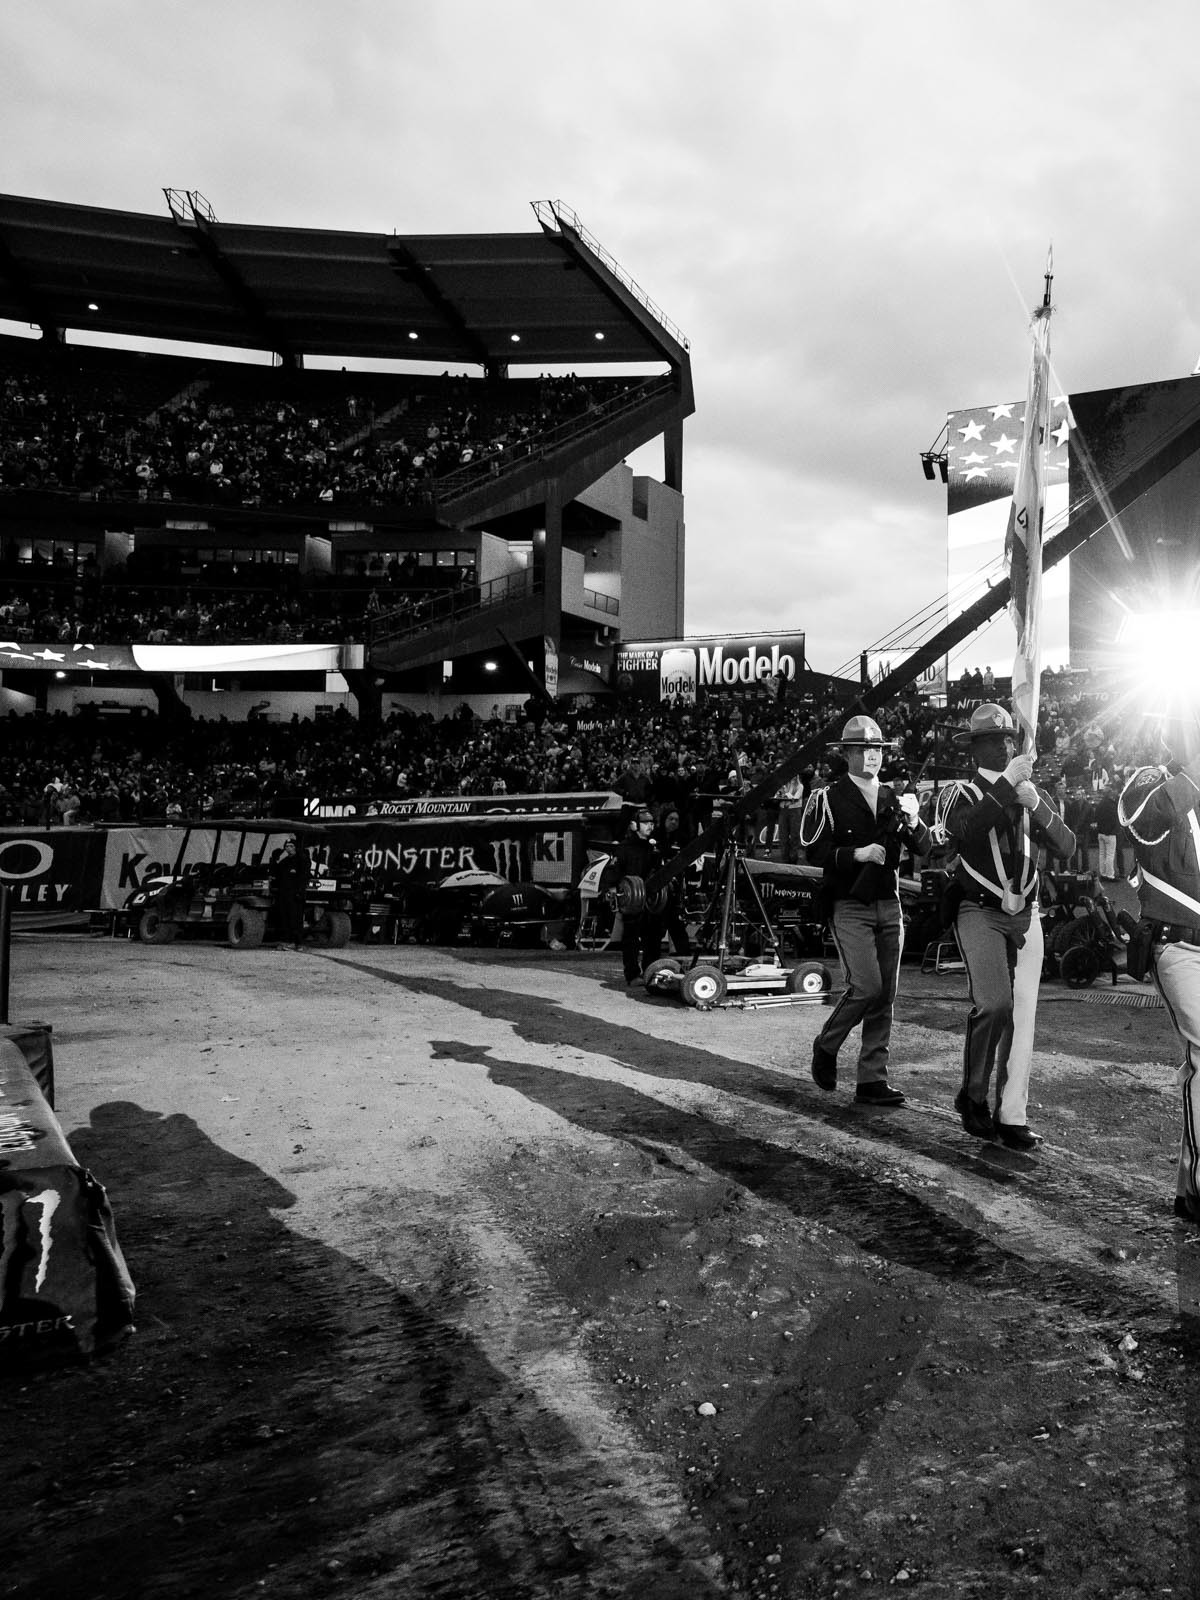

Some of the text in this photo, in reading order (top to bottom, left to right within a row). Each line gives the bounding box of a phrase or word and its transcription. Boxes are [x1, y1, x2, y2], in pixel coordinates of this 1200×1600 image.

[617, 652, 628, 660] THE
[617, 659, 658, 671] FIGHTER
[699, 645, 795, 685] Modelo
[379, 802, 472, 815] ROCKY MOUNTAIN
